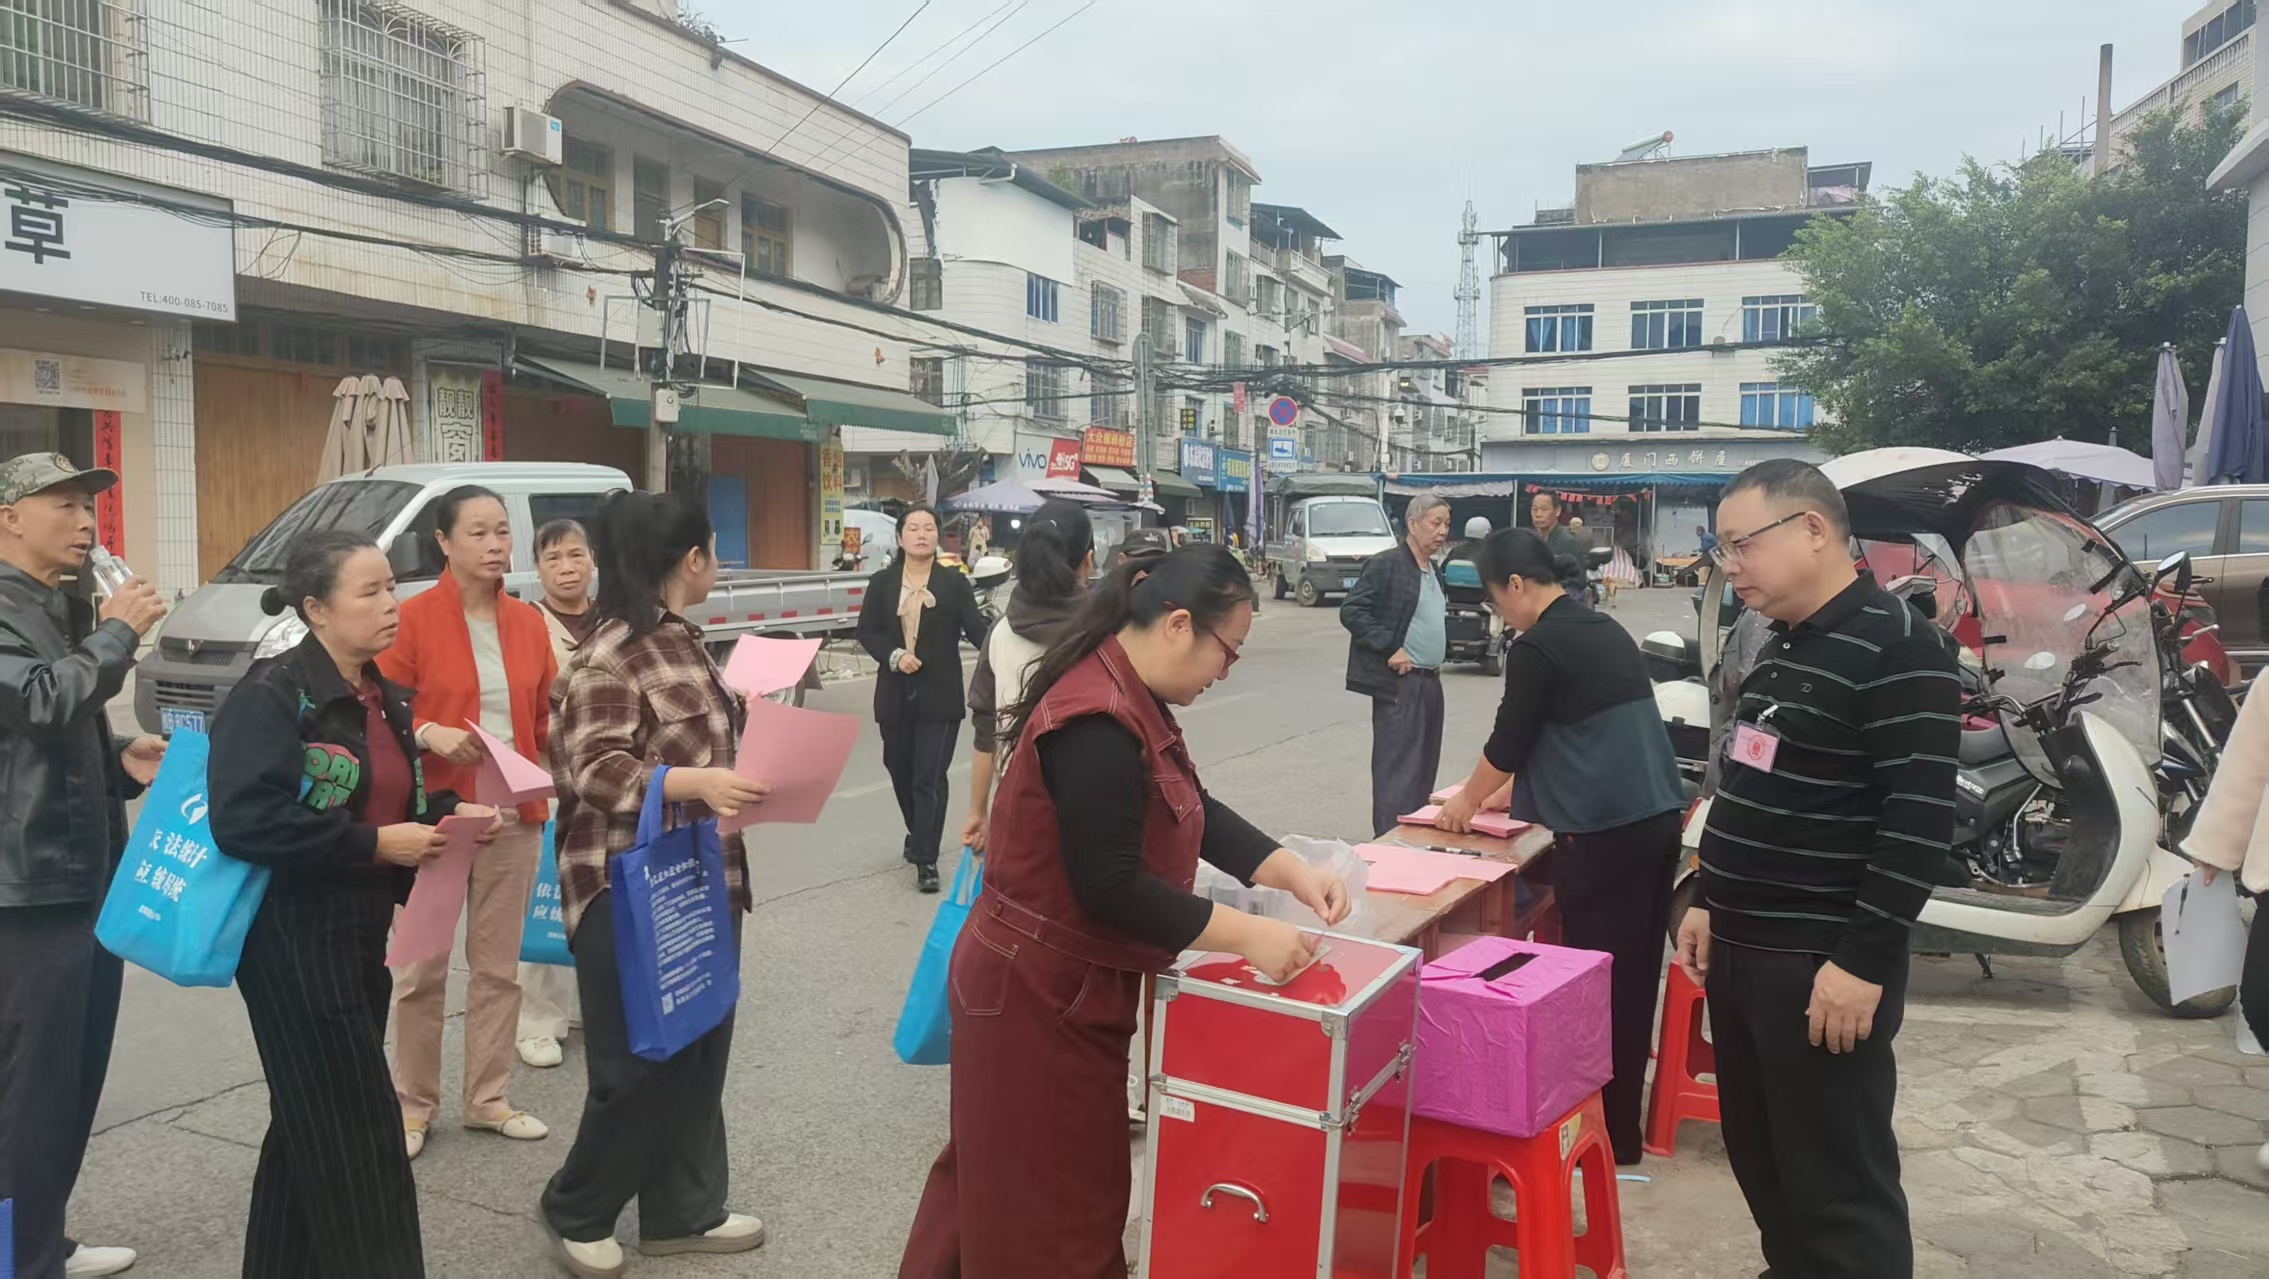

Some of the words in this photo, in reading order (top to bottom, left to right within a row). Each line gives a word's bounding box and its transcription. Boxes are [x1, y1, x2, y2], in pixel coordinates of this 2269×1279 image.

[4, 186, 71, 264] 草
[140, 291, 228, 313] TEL:400-085-7085
[1018, 448, 1047, 469] vivo
[1618, 449, 1728, 468] 厦门西饼屋
